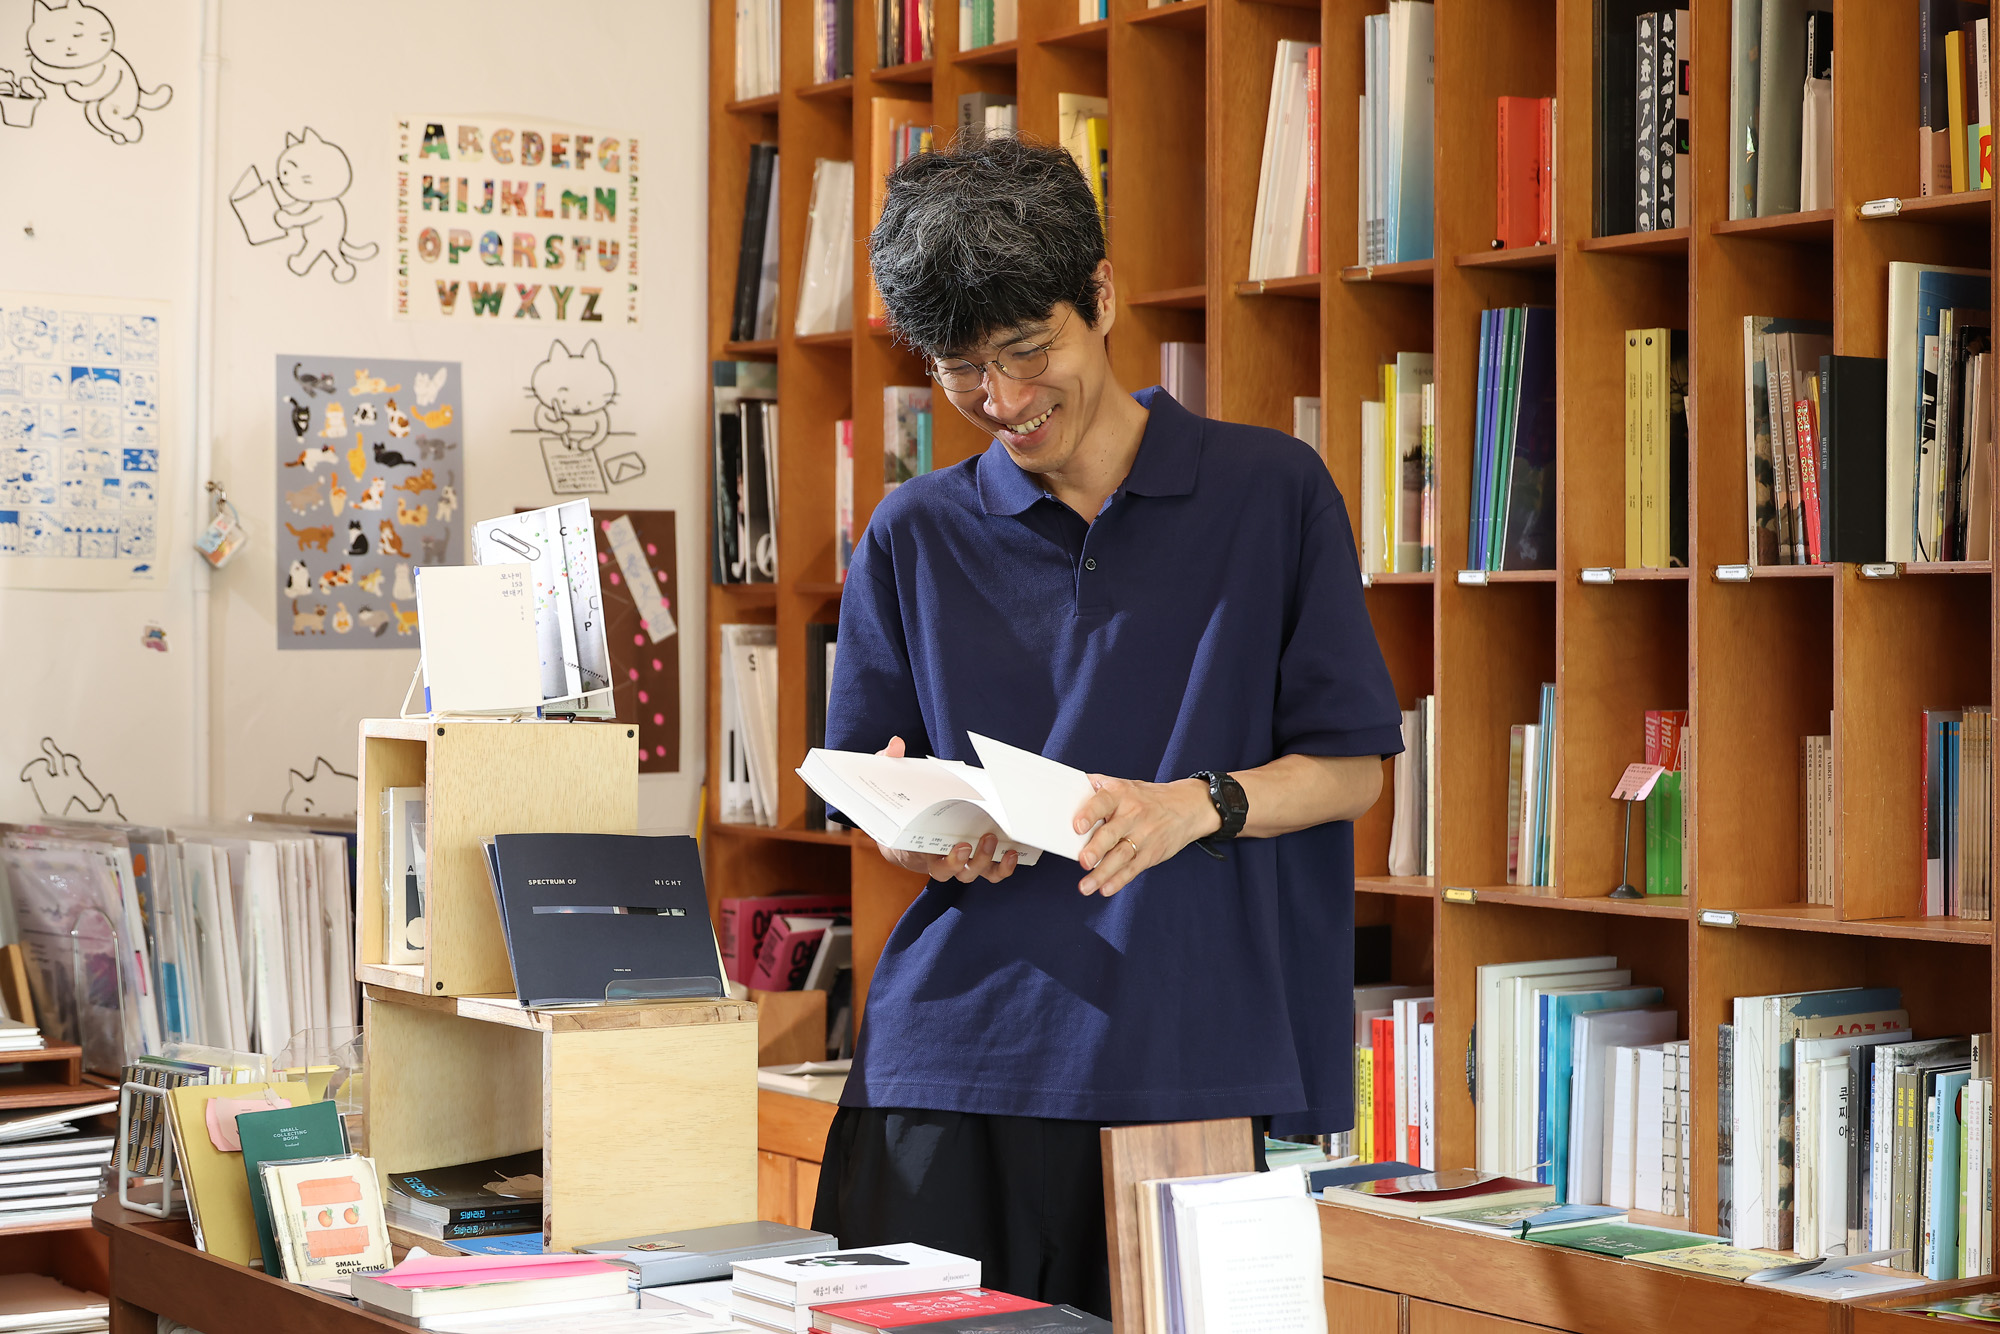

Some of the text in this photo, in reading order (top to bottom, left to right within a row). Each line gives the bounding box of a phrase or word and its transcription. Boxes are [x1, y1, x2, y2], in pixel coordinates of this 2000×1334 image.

[1768, 371, 1784, 492] Killing and Dying
[1781, 371, 1798, 491] Killing and Dying
[500, 572, 522, 580] 모나미
[584, 621, 592, 632] P
[528, 878, 566, 886] SPECTRUM
[273, 1129, 307, 1138] COLLECTING
[460, 1209, 486, 1220] 되바라진
[335, 1260, 362, 1268] SMALL
[337, 1263, 386, 1275] COLLECTING
